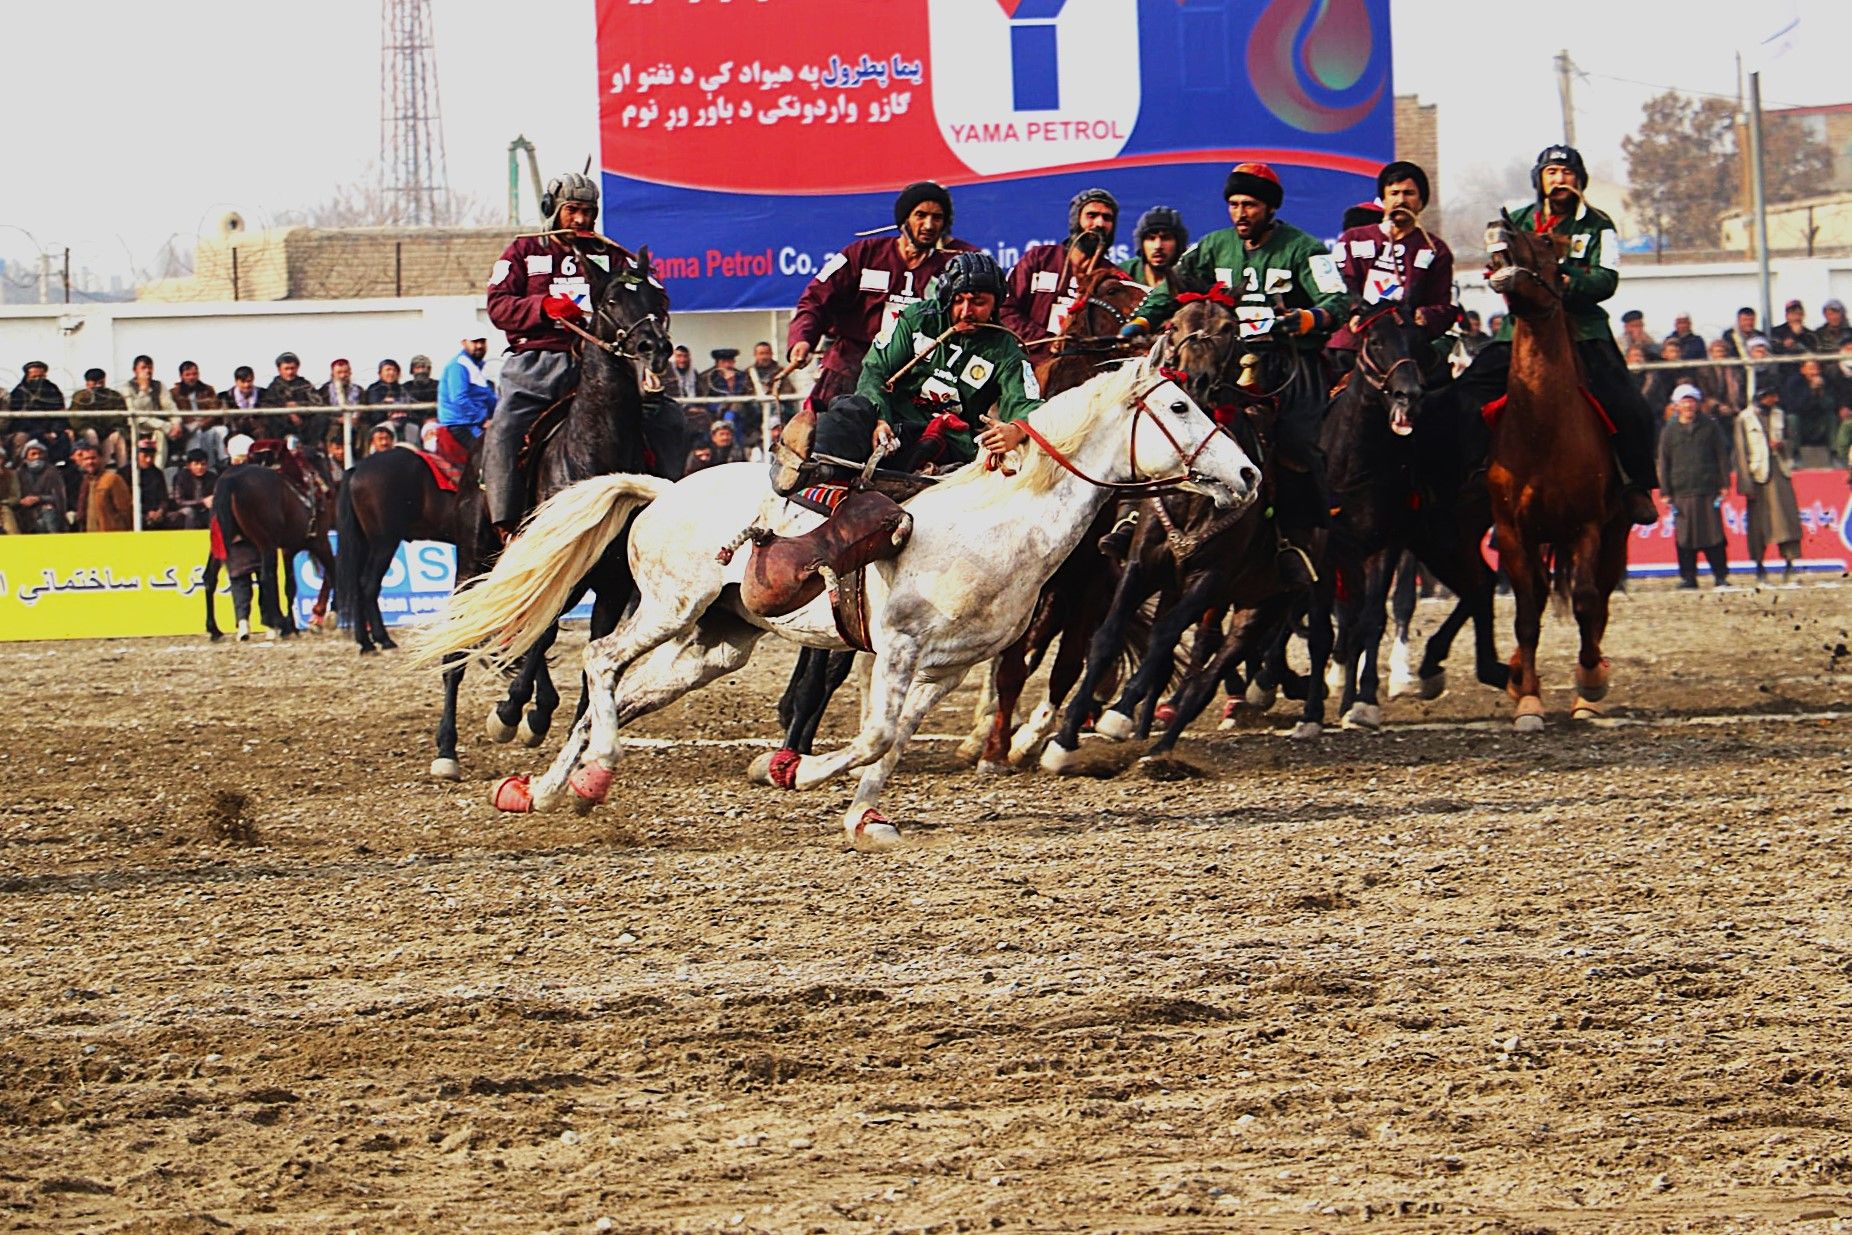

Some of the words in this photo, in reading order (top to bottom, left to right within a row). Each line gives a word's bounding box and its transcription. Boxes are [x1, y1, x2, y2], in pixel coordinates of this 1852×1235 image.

[610, 62, 631, 93] او
[637, 62, 675, 93] نفتو
[680, 66, 694, 84] د
[739, 60, 793, 90] هیواد
[799, 64, 819, 90] په
[821, 54, 890, 88] پطرول
[622, 99, 658, 127] نوم
[693, 96, 733, 125] باور
[739, 100, 752, 118] د
[950, 123, 1019, 143] YAMA
[1026, 120, 1124, 141] PETROL
[560, 255, 577, 276] 6
[705, 248, 774, 277] Petrol
[779, 246, 818, 275] Co.
[901, 271, 914, 295] 1
[946, 343, 963, 368] 7
